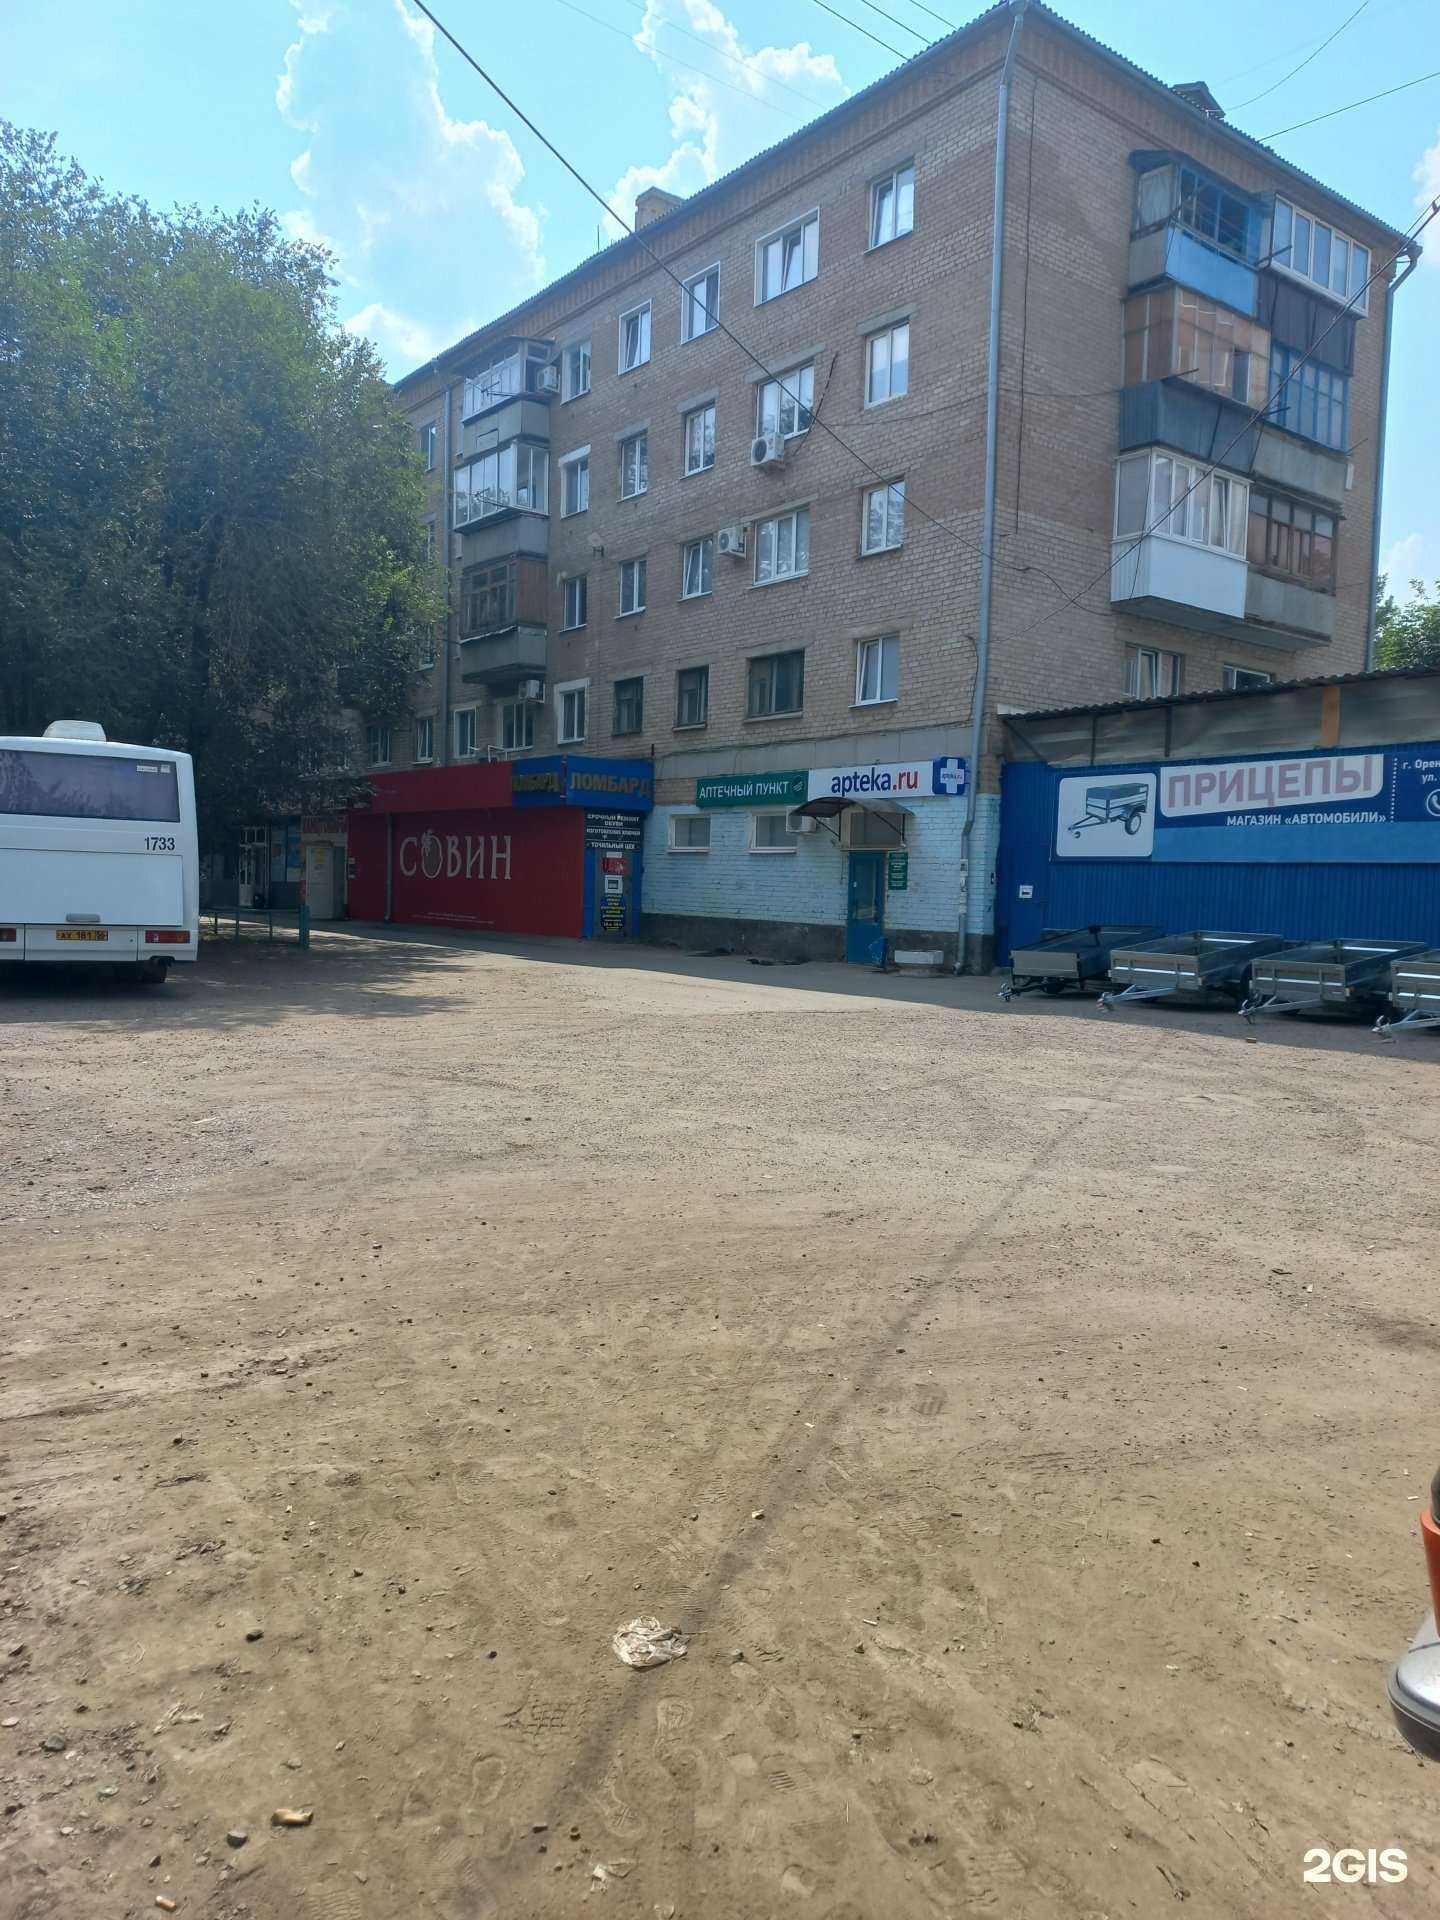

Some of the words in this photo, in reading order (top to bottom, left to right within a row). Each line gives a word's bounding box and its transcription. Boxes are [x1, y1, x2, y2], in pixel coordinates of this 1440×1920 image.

[569, 772, 653, 798] ЛОМБАРД
[831, 767, 919, 797] apteka.ru
[1167, 756, 1373, 808] ПРИЦЕПЫ
[1421, 774, 1437, 785] ул.
[699, 780, 753, 799] АПТЕЧНЫЙ
[755, 780, 789, 796] ПУНКТ
[1227, 813, 1281, 826] МАГАЗИН
[1284, 811, 1386, 825] «АВТОМОБИЛИ»
[144, 836, 176, 851] 1733
[591, 841, 624, 849] ТОЧИЛЬНЫЙ
[399, 832, 512, 880] СОВИН
